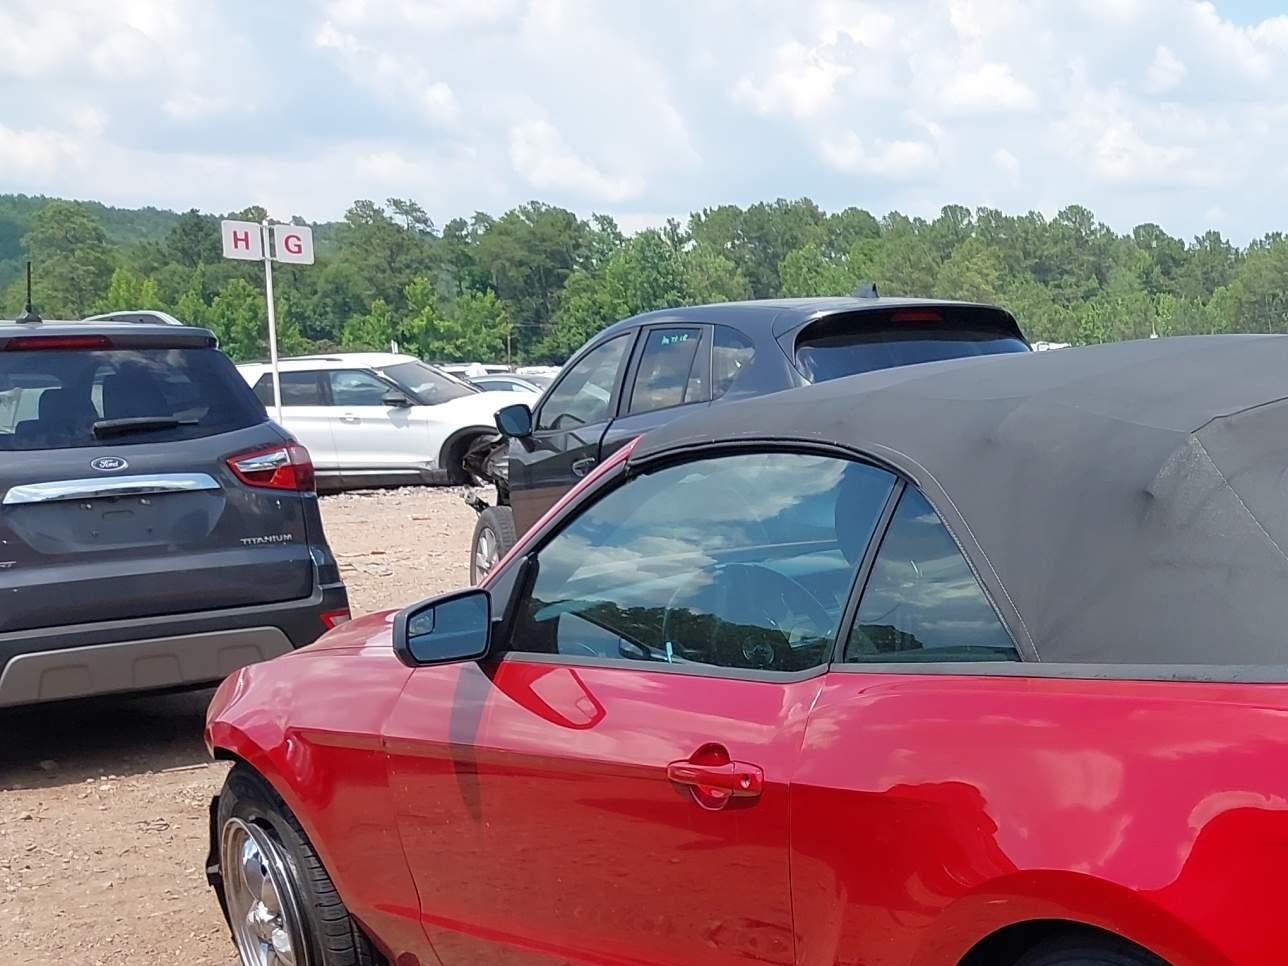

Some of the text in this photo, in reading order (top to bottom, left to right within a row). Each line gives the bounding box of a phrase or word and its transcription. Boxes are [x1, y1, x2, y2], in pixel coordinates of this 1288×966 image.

[233, 230, 249, 250] H
[283, 234, 303, 254] G
[240, 534, 292, 546] TITANIUM
